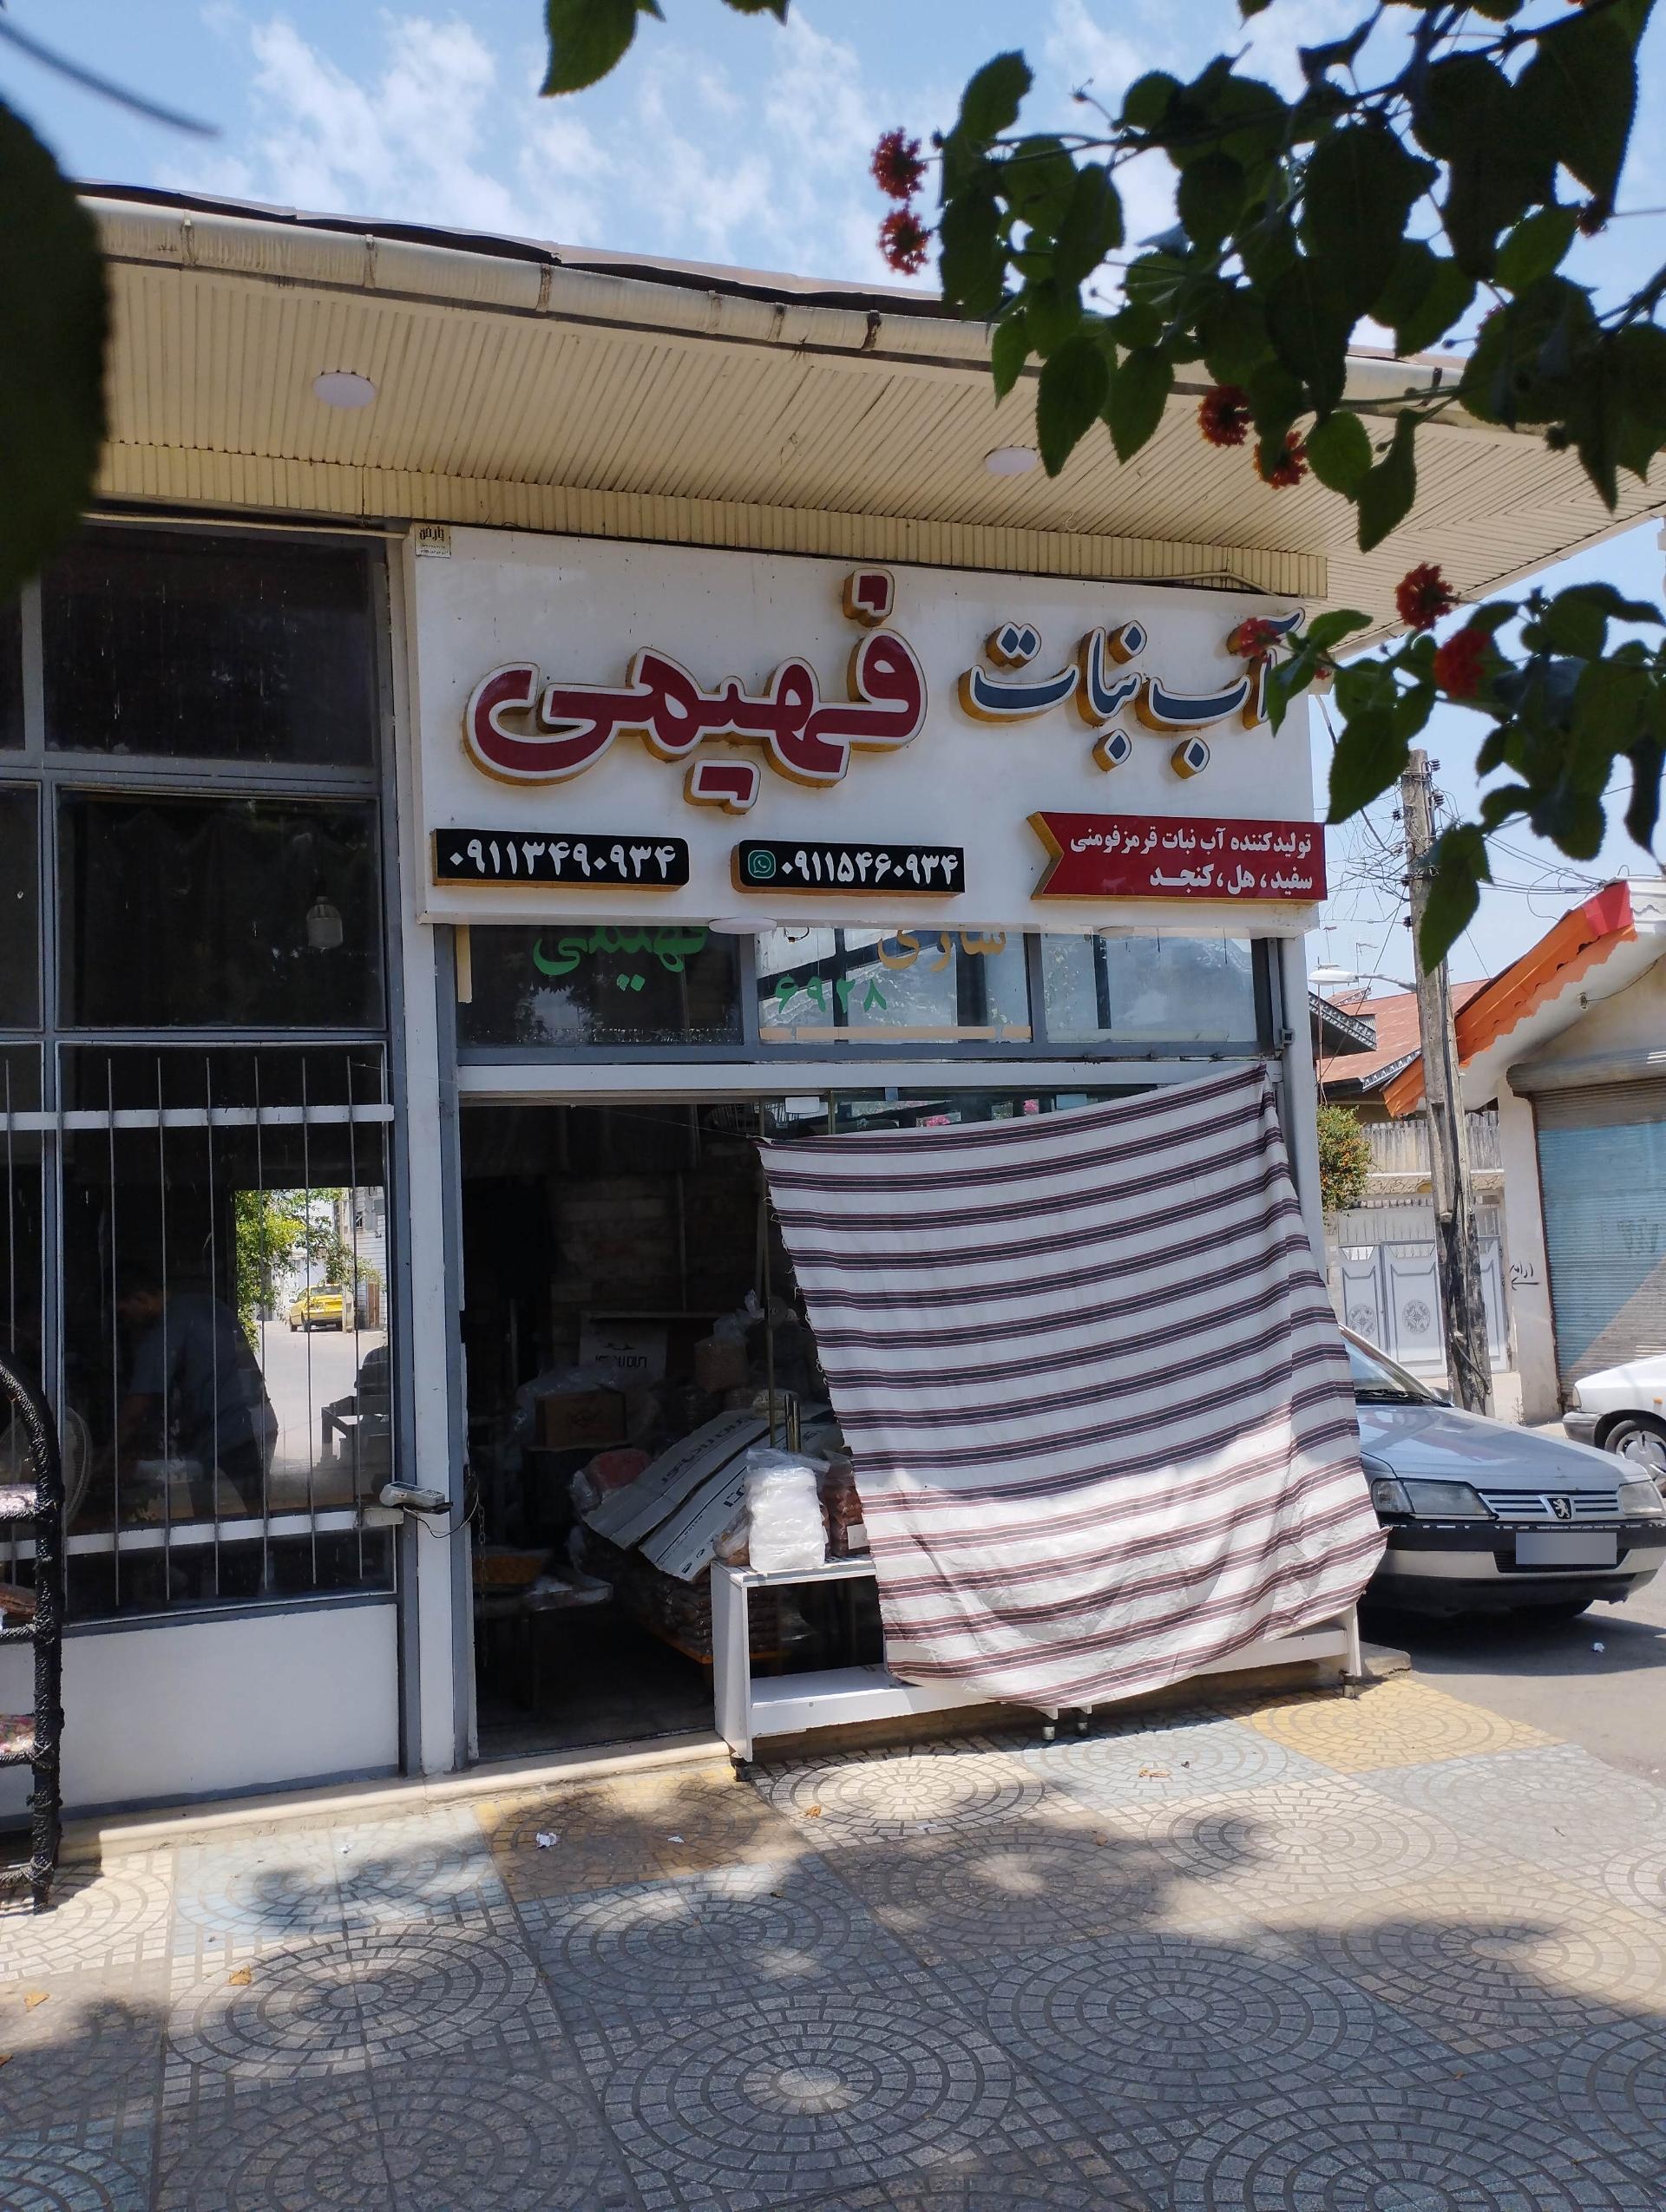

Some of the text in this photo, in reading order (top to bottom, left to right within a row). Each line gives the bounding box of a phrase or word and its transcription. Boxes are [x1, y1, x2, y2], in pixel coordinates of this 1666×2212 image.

[465, 567, 928, 815] فهیمی
[963, 620, 1145, 771] نبات
[449, 838, 677, 880] ۰۹۱۱۳۴۹۰۹۳۴
[1162, 828, 1197, 854] نبات
[1200, 827, 1226, 855] آب
[781, 849, 959, 886] ۰۹۱۱۵۴۶۰۹۳۴
